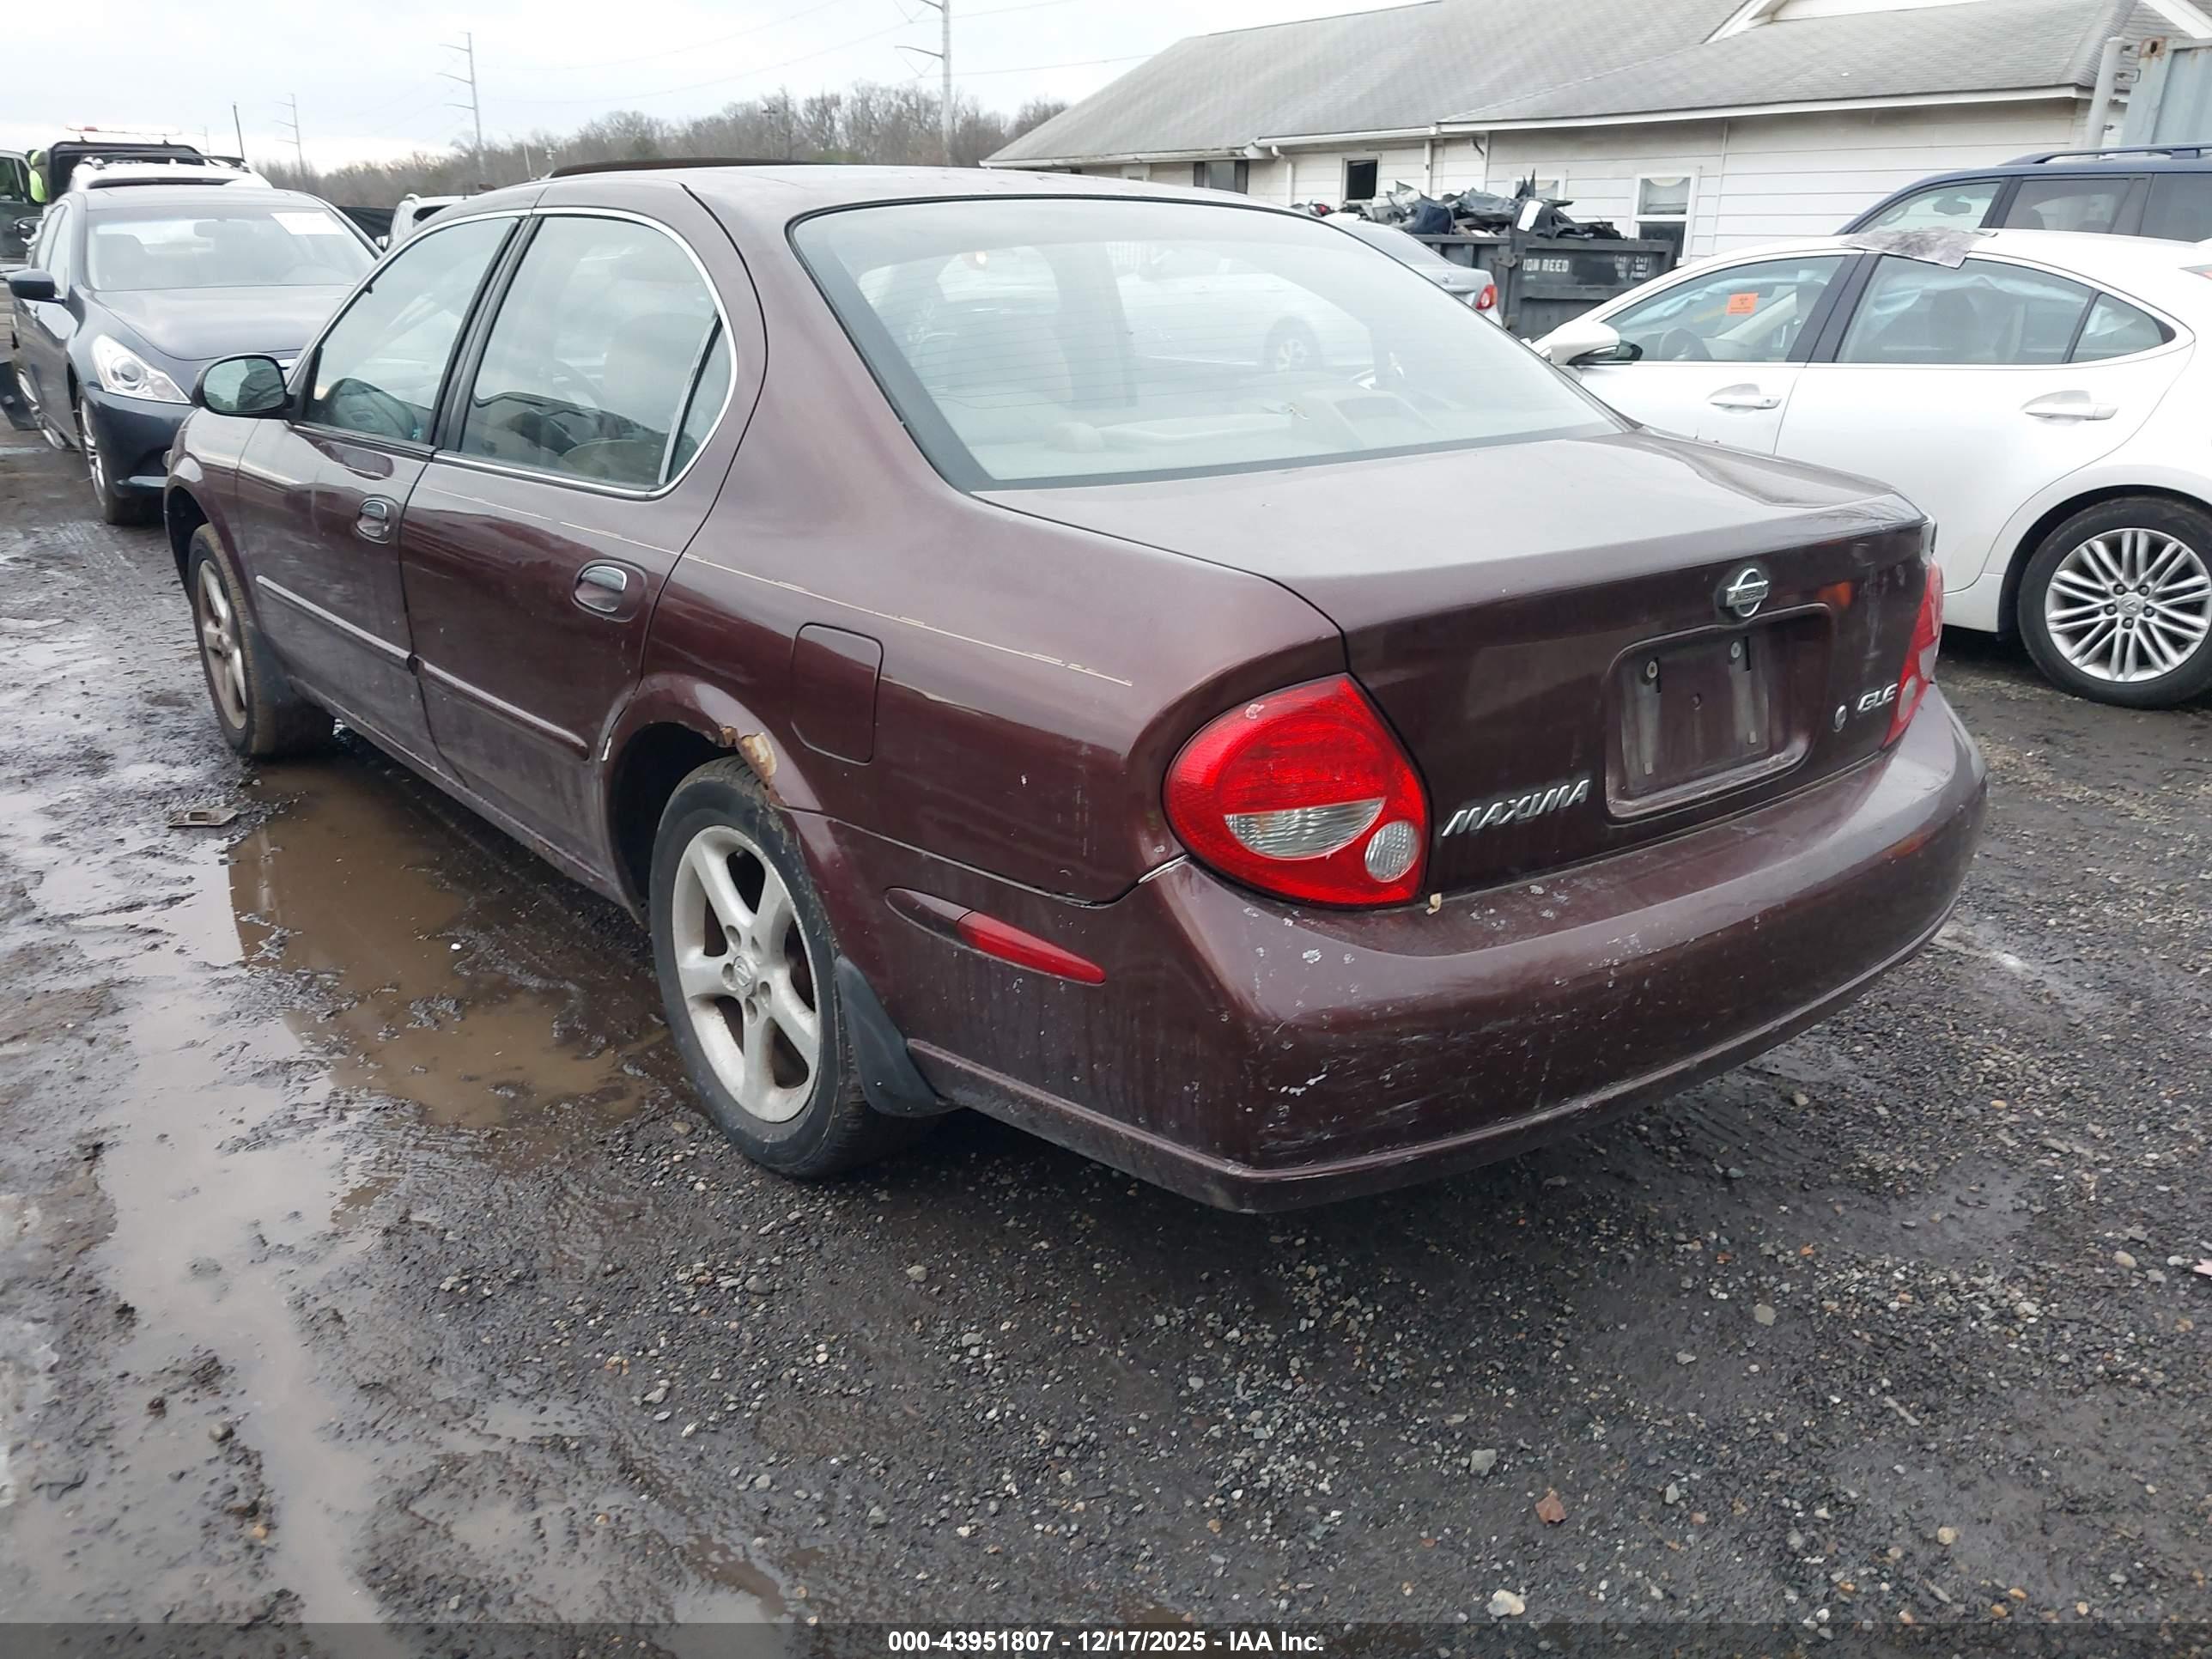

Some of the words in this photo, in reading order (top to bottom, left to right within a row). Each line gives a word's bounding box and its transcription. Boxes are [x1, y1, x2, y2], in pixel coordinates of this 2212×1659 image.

[1541, 258, 1570, 273] REED
[1856, 683, 1899, 712] GLE
[1441, 779, 1590, 837] MAXIMA
